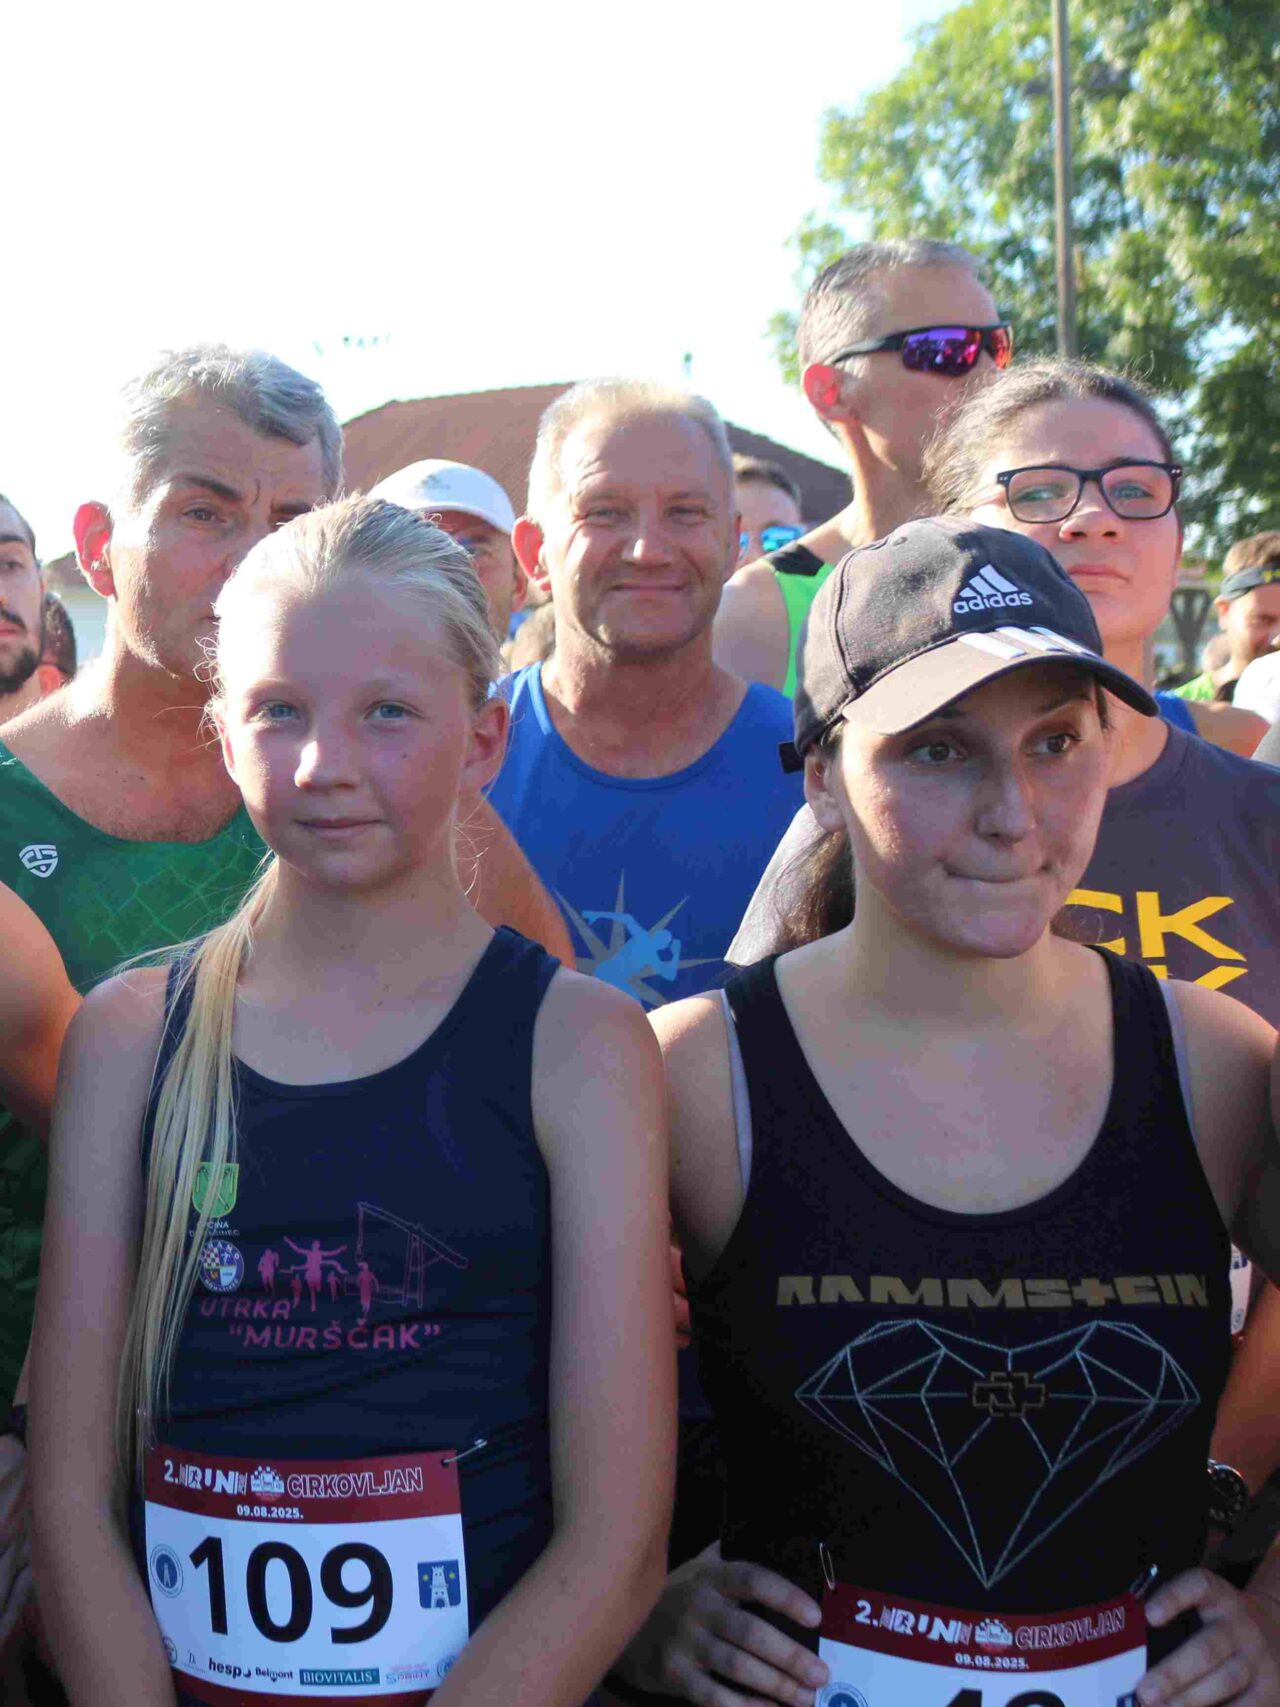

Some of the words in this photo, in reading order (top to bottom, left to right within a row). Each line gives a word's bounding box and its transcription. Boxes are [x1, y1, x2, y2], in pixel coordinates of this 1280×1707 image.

[953, 592, 1033, 614] adidas
[200, 1299, 292, 1320] UTRKA
[164, 1459, 179, 1485] 2.
[186, 1465, 239, 1494] RUN
[287, 1467, 424, 1498] CIRKOVLJAN
[236, 1503, 304, 1520] 09.08.2025.
[189, 1535, 394, 1644] 109
[855, 1600, 879, 1626] 2.
[1015, 1606, 1126, 1650] CIRKOVLJAN
[955, 1652, 1029, 1670] 09.08.2025.
[255, 1667, 293, 1682] Belmont
[302, 1671, 374, 1684] BIOVITALIS
